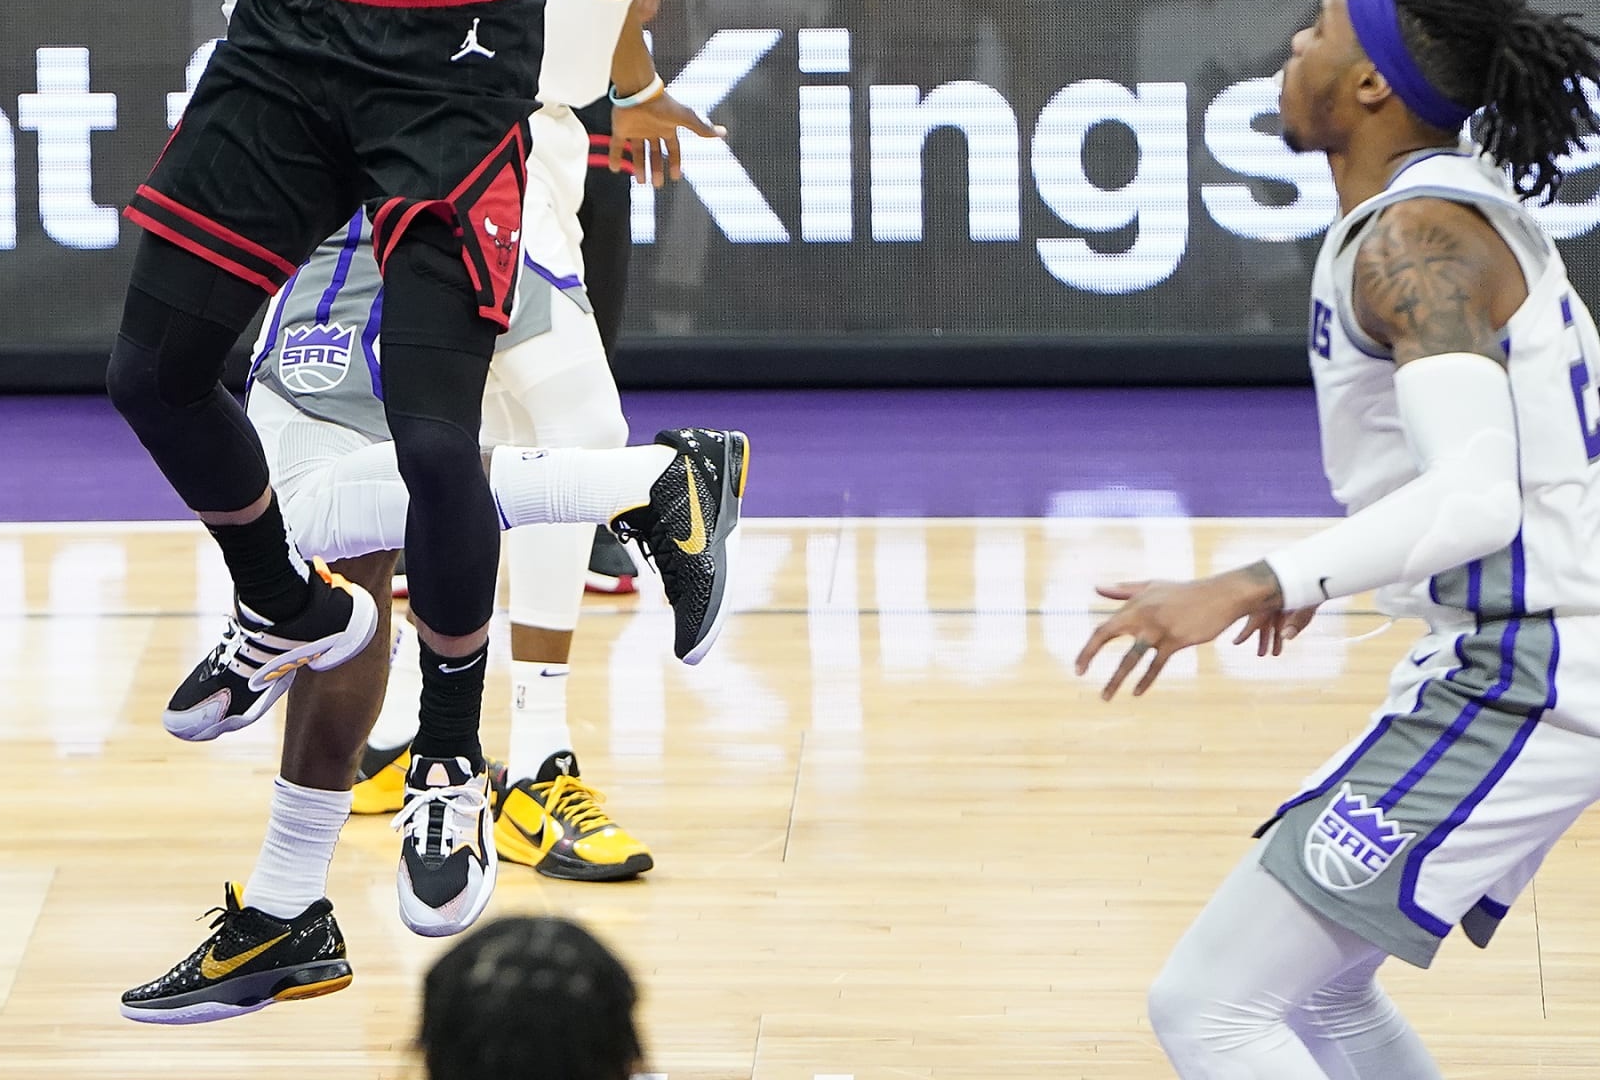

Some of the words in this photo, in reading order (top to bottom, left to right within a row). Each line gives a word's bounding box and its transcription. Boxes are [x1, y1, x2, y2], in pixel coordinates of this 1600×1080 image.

[630, 26, 1340, 295] Kings
[282, 347, 348, 368] SAC
[1317, 814, 1387, 873] SAC
